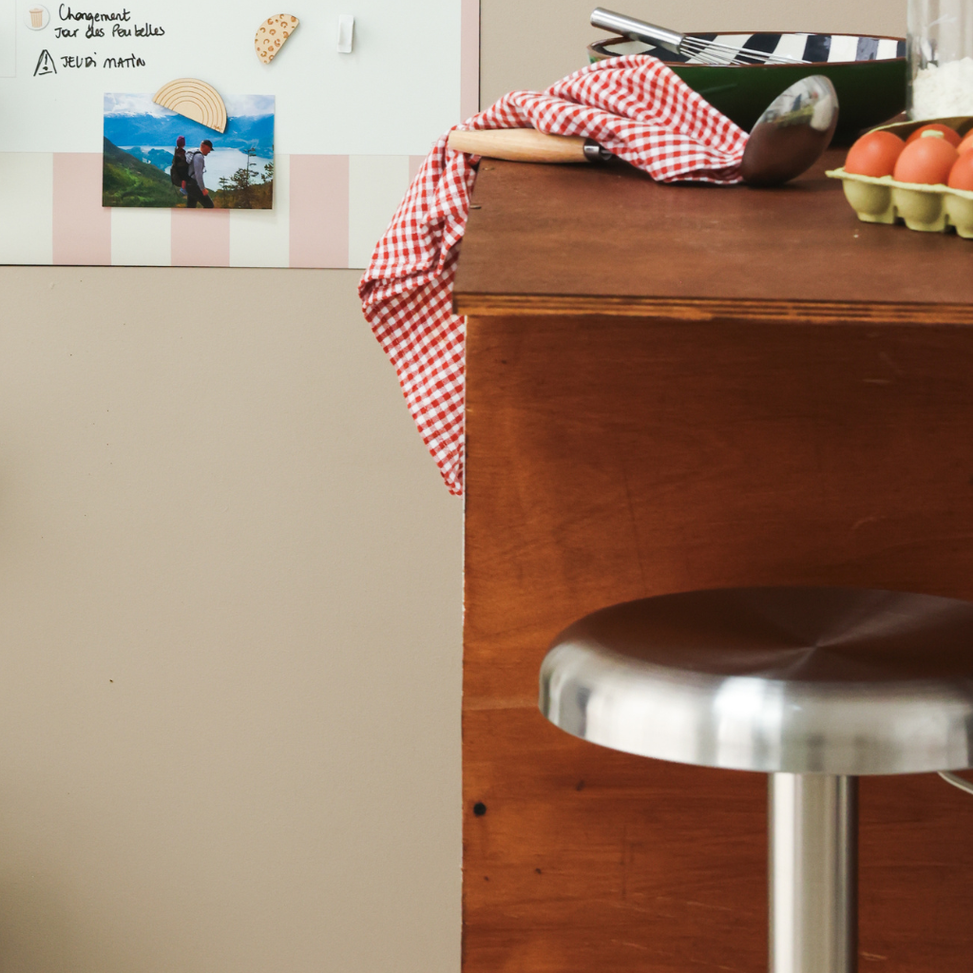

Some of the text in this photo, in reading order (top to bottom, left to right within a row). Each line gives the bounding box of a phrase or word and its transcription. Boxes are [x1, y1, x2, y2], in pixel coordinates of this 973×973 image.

[58, 3, 131, 26] Changement
[54, 27, 80, 39] Jour
[84, 24, 106, 39] des
